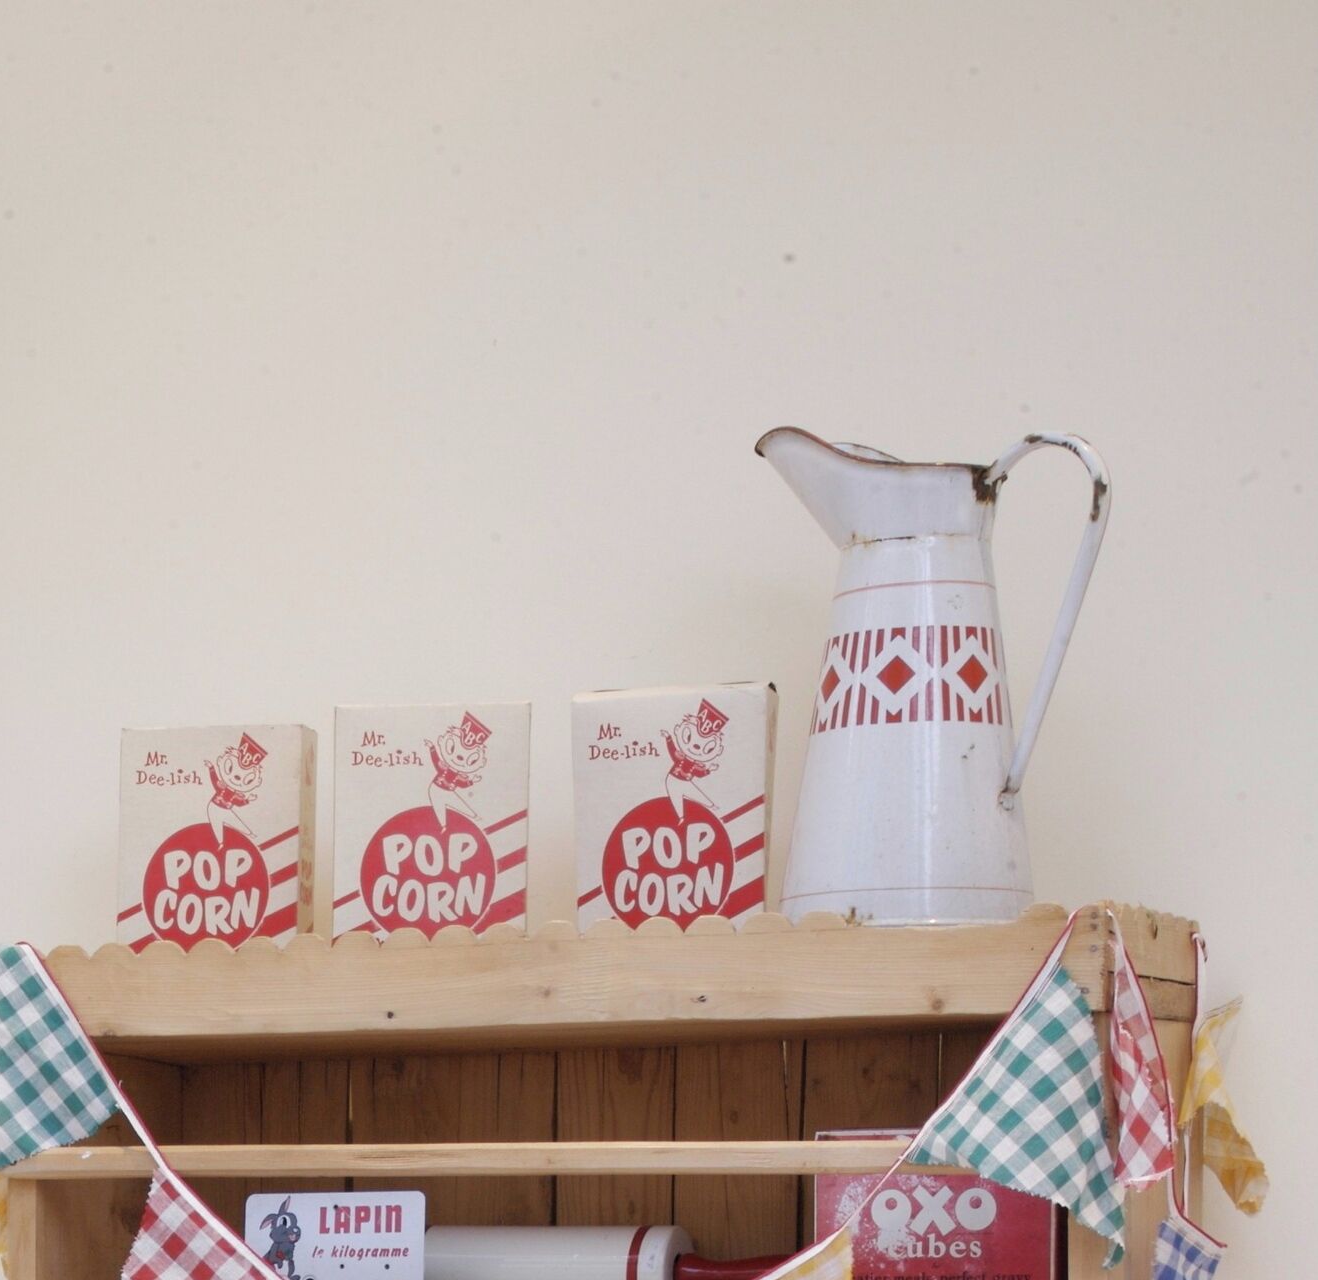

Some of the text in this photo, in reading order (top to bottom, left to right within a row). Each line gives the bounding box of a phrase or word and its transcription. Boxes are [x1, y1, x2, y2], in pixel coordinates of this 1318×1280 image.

[461, 721, 485, 745] ABC
[597, 723, 621, 740] Mr.
[698, 709, 722, 734] ABC
[361, 731, 386, 747] Mr.
[588, 741, 660, 760] Dee-lish
[144, 751, 168, 767] Mr.
[239, 742, 260, 765] ABC
[351, 749, 424, 767] Dee-lish
[136, 769, 203, 785] Dee-lish
[382, 833, 478, 876] POP
[621, 822, 716, 870] POP
[163, 849, 253, 891] POP
[372, 873, 486, 923] CORN
[614, 862, 724, 916] CORN
[153, 888, 260, 935] CORN
[319, 1204, 402, 1234] LAPIN
[871, 1184, 997, 1236] OXO
[331, 1245, 410, 1261] kilogramme
